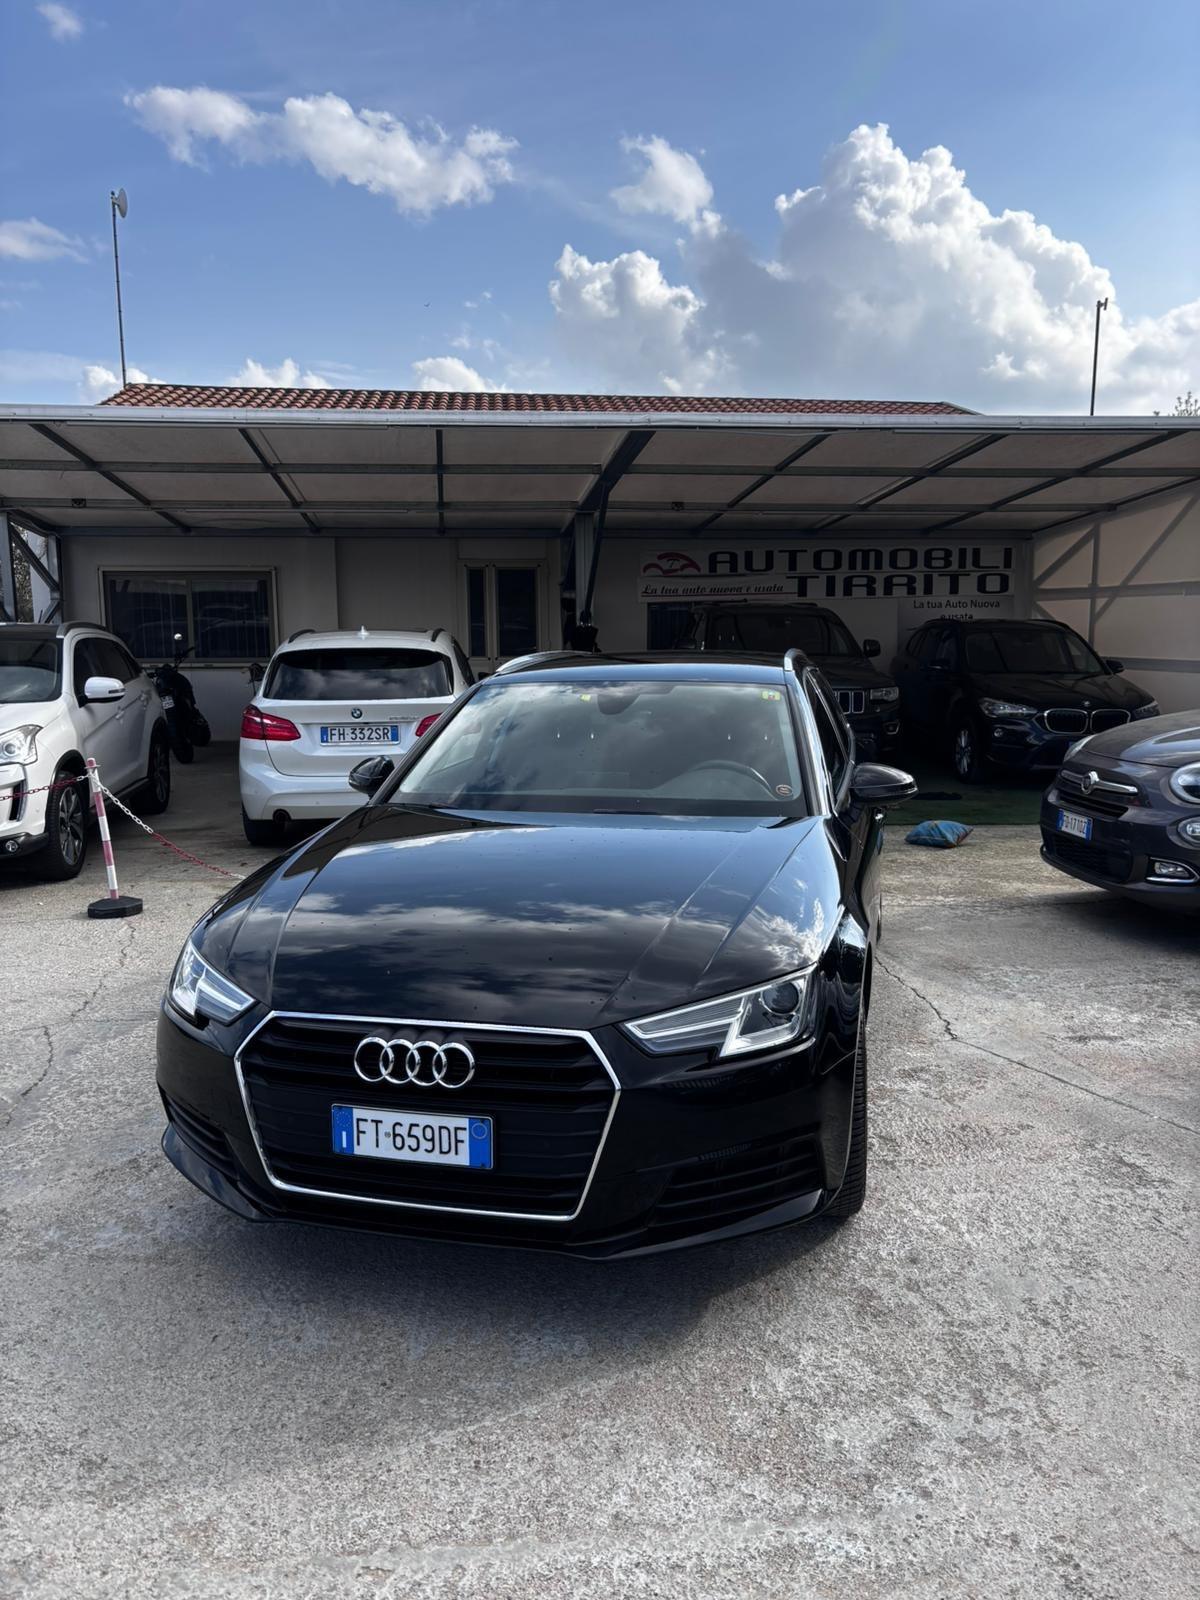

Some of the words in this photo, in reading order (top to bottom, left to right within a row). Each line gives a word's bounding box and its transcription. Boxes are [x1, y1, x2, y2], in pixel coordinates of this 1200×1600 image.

[708, 548, 1012, 574] AUTOMOBILI
[642, 584, 657, 595] La
[660, 585, 679, 595] tua
[682, 584, 706, 594] auto
[786, 572, 1010, 598] TIRRITO
[913, 600, 925, 609] La
[927, 600, 942, 609] tua
[945, 599, 968, 609] Auto
[970, 599, 1000, 609] Nuova
